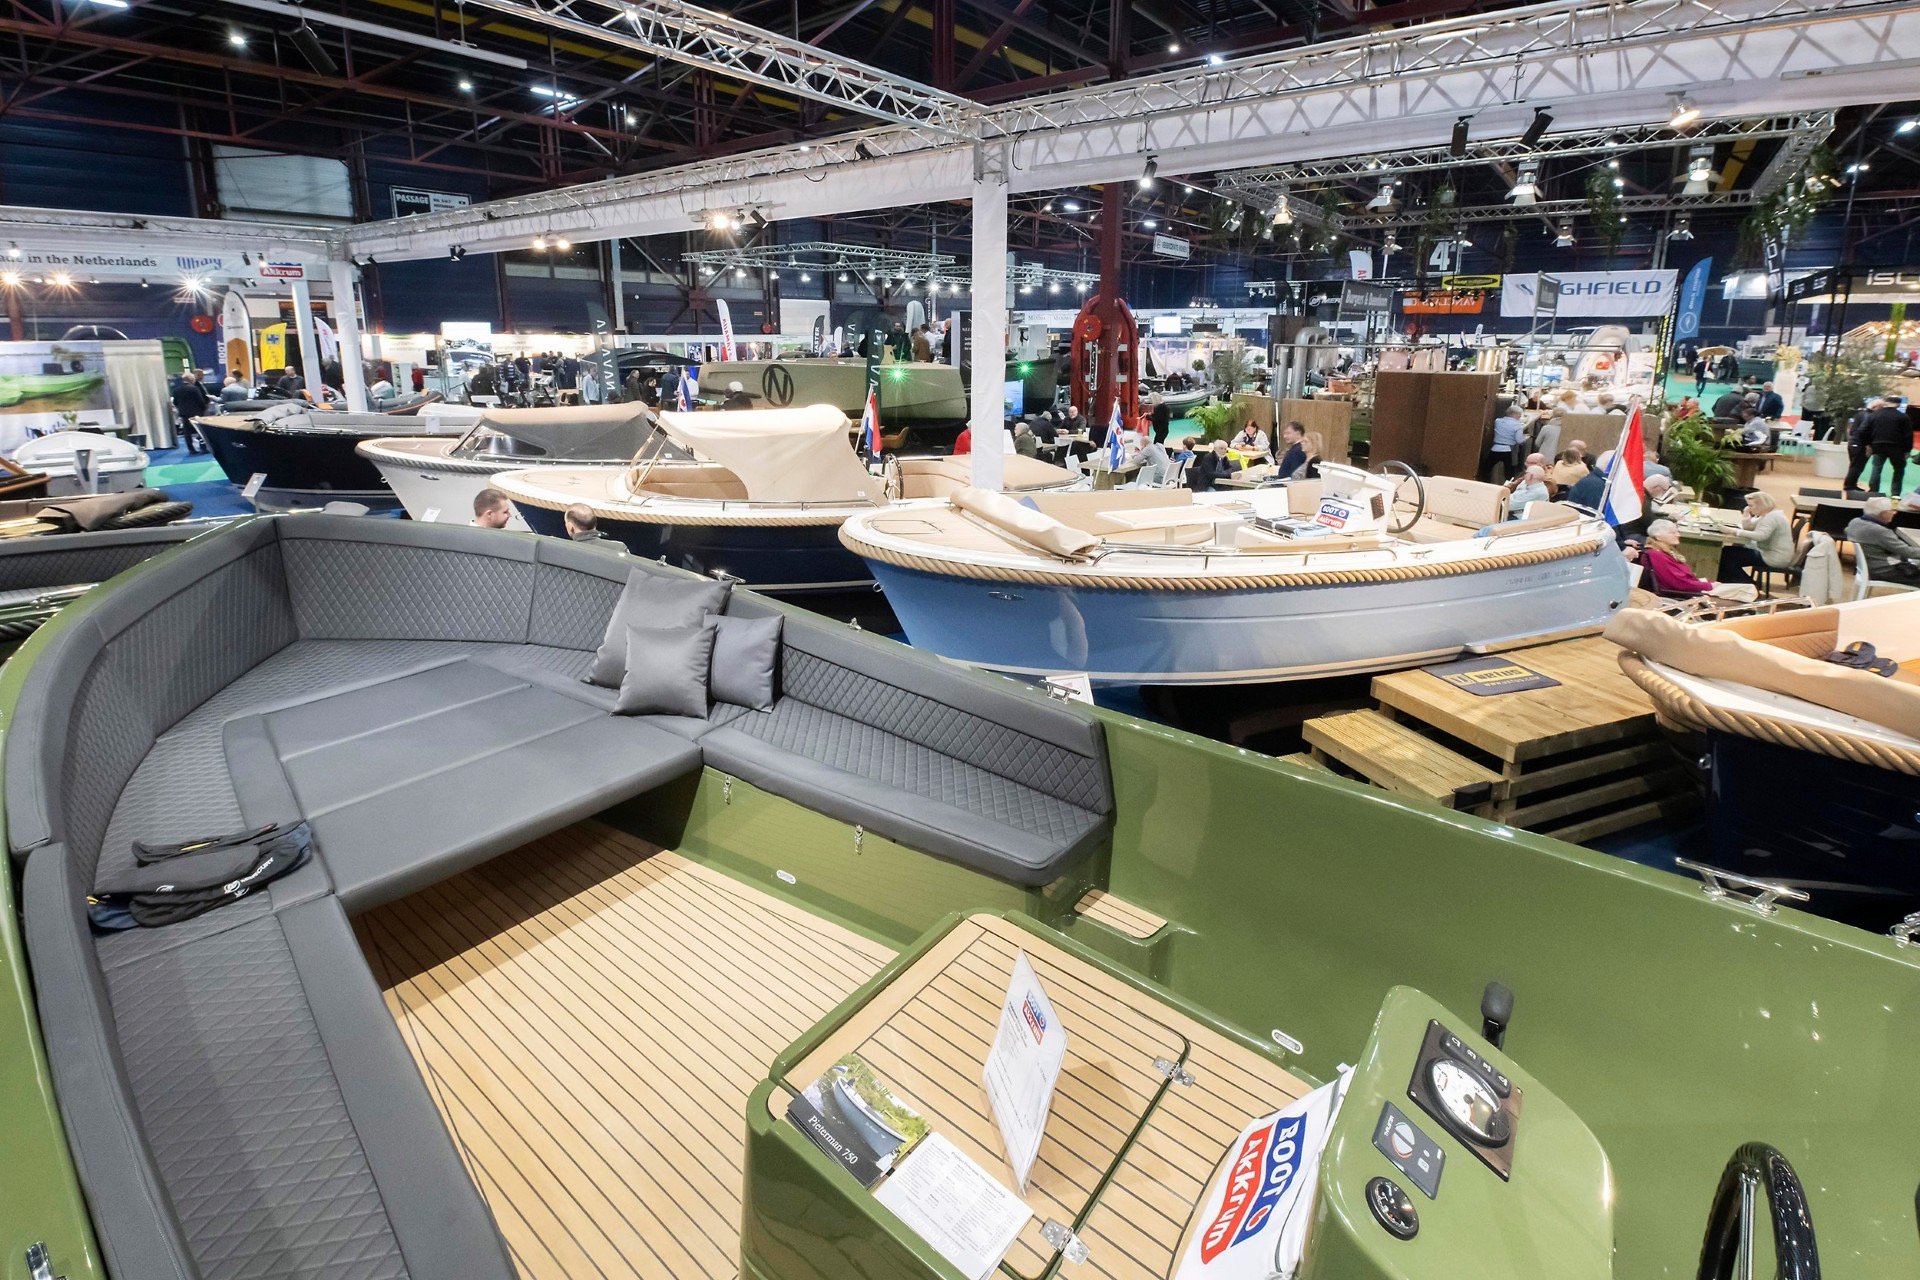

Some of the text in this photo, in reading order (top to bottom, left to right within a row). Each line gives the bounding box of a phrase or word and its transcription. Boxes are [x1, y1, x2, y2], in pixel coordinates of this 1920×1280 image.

[396, 193, 429, 204] PASSAGE
[27, 253, 42, 264] in
[46, 254, 69, 264] the
[73, 255, 157, 267] Netherlands
[1429, 241, 1450, 270] 4
[262, 267, 301, 277] Akkrum
[1540, 280, 1662, 296] GHFIELD
[808, 1115, 859, 1165] Pieterman 750
[1262, 1120, 1300, 1198] BOOT
[1205, 1138, 1263, 1250] Akkrum
